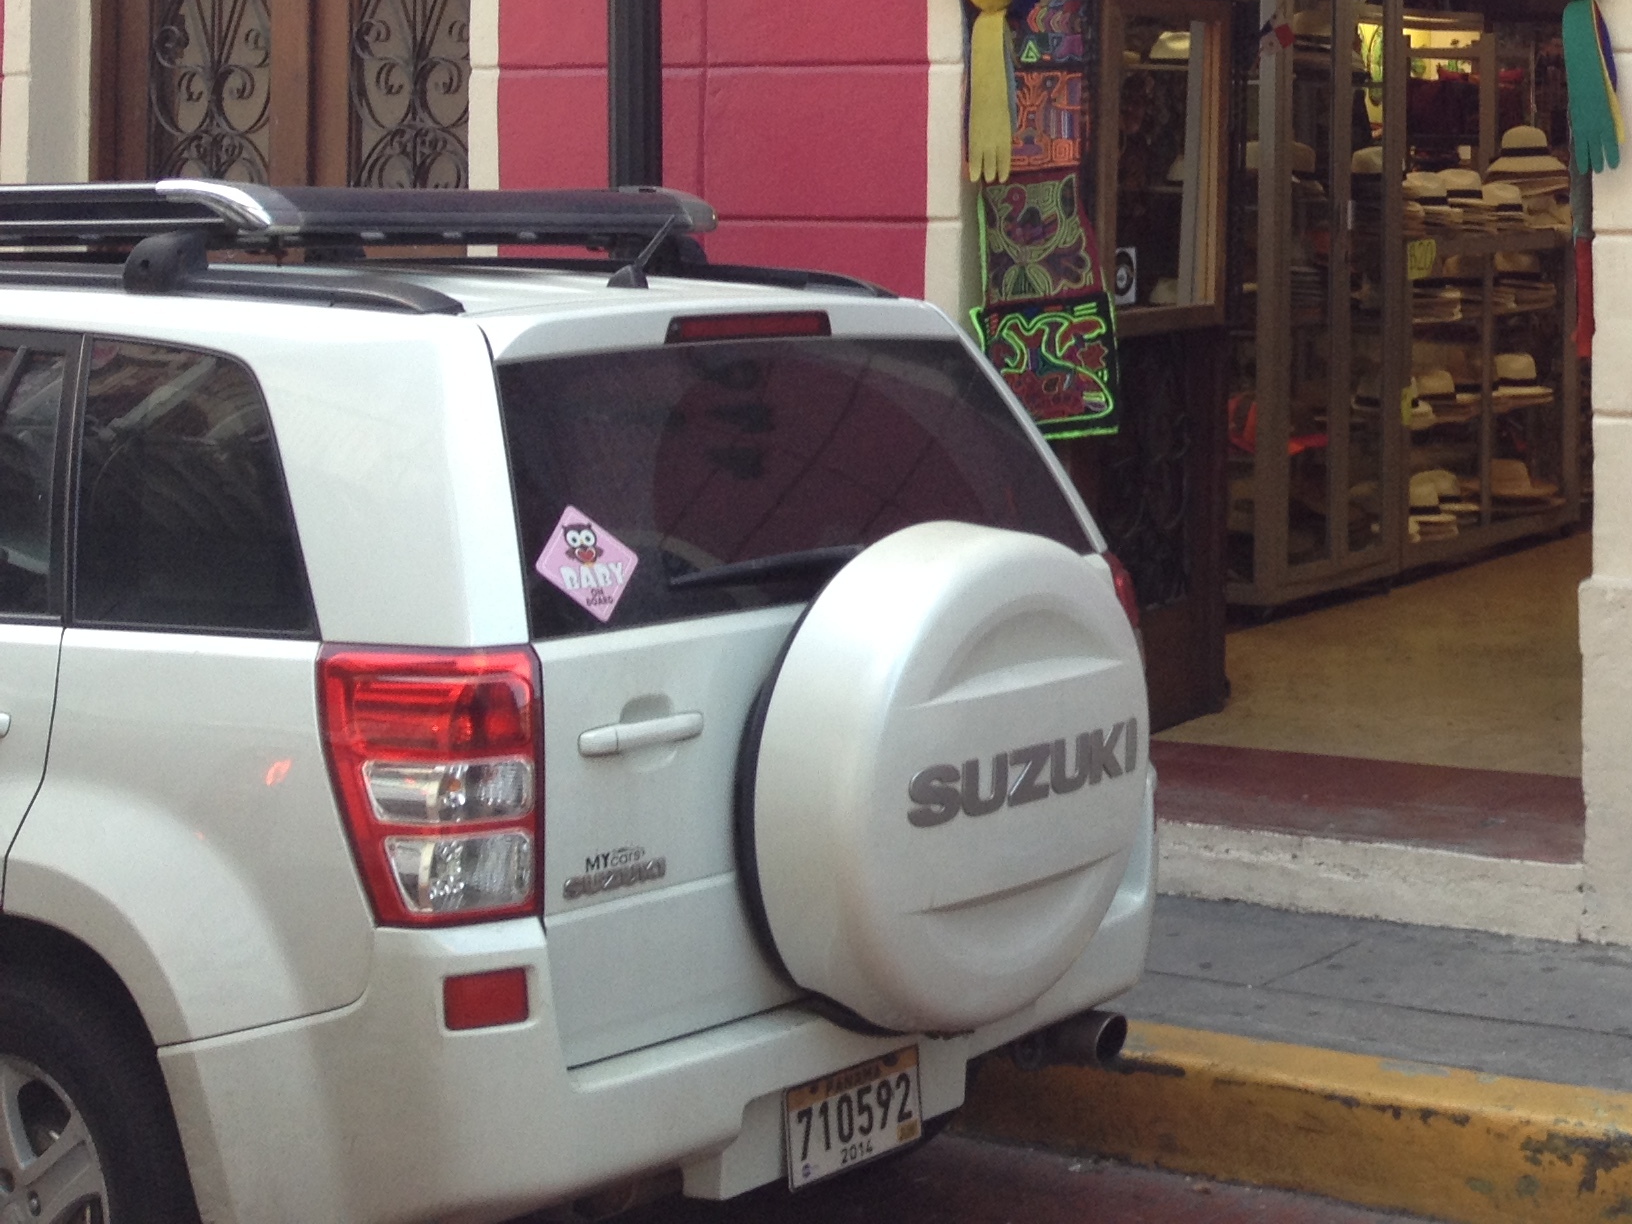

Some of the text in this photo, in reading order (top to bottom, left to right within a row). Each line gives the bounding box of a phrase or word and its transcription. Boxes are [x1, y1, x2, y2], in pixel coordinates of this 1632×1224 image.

[560, 561, 624, 591] BABY
[585, 595, 614, 607] BOARD
[590, 587, 604, 597] ON
[906, 716, 1138, 828] SUZUKI
[562, 856, 667, 901] SUZUKI
[796, 1072, 913, 1162] 710592
[840, 1140, 874, 1165] 2014
